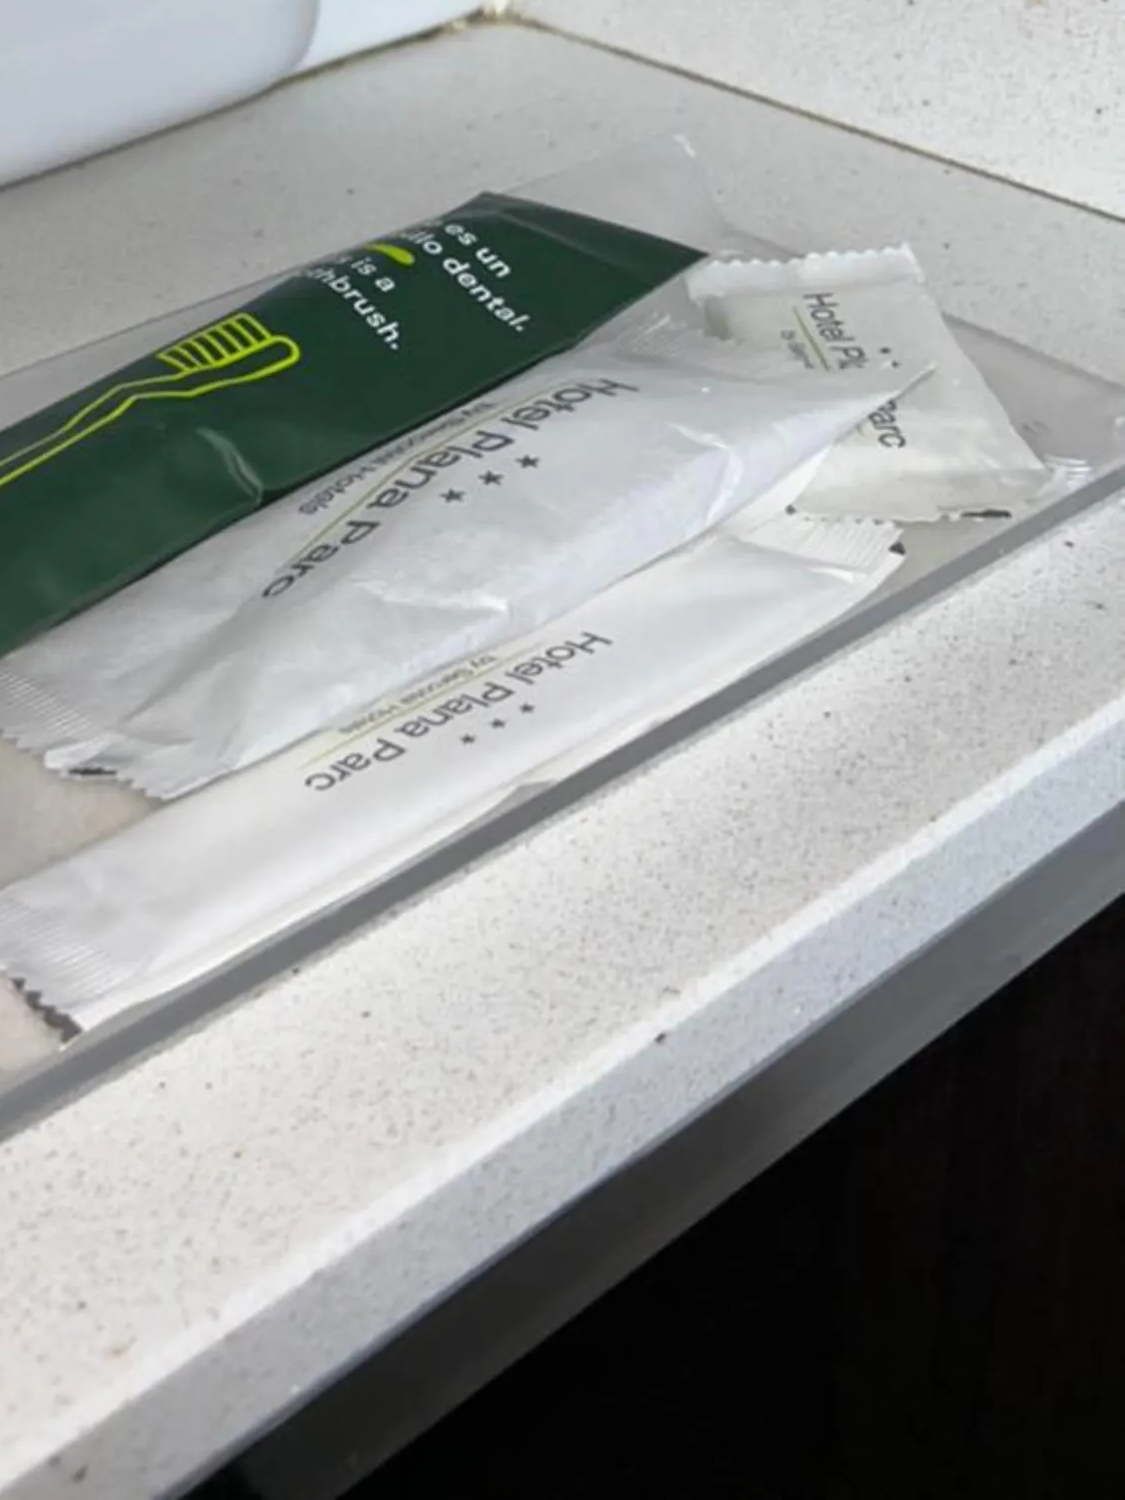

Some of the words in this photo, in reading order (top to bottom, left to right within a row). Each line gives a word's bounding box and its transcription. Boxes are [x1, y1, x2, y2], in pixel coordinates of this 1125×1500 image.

[351, 256, 377, 276] is
[375, 276, 396, 292] a
[444, 222, 478, 246] es
[475, 247, 511, 278] un
[442, 257, 530, 332] dental.
[803, 292, 856, 342] Hotel
[502, 377, 640, 431] Hotel
[368, 429, 515, 510] Plana
[261, 519, 381, 598] Parc
[505, 631, 613, 685] Hotel
[394, 681, 516, 739] Plana
[304, 737, 407, 791] Parc
